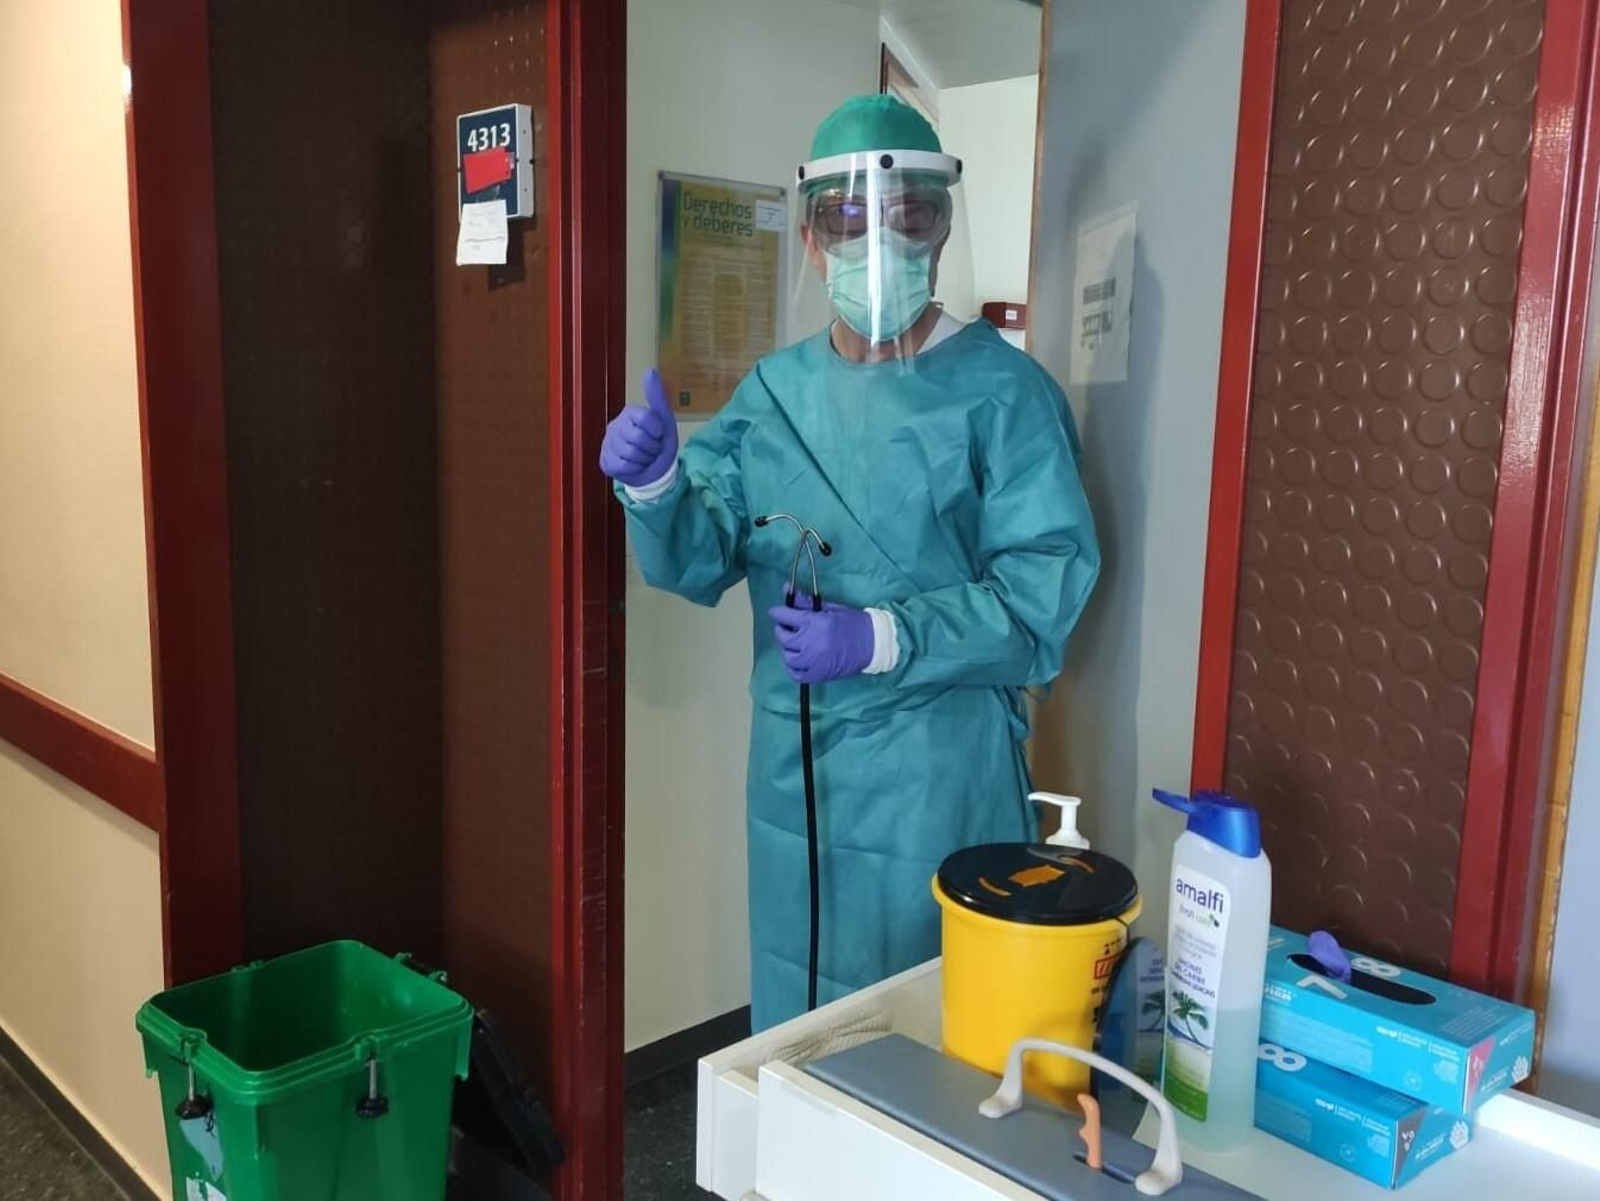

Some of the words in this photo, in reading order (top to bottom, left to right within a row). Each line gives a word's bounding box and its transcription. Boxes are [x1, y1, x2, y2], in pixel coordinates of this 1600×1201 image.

[467, 122, 511, 152] 4313
[683, 191, 752, 220] Derechos
[693, 211, 753, 237] deberes
[1176, 878, 1224, 913] amalfi
